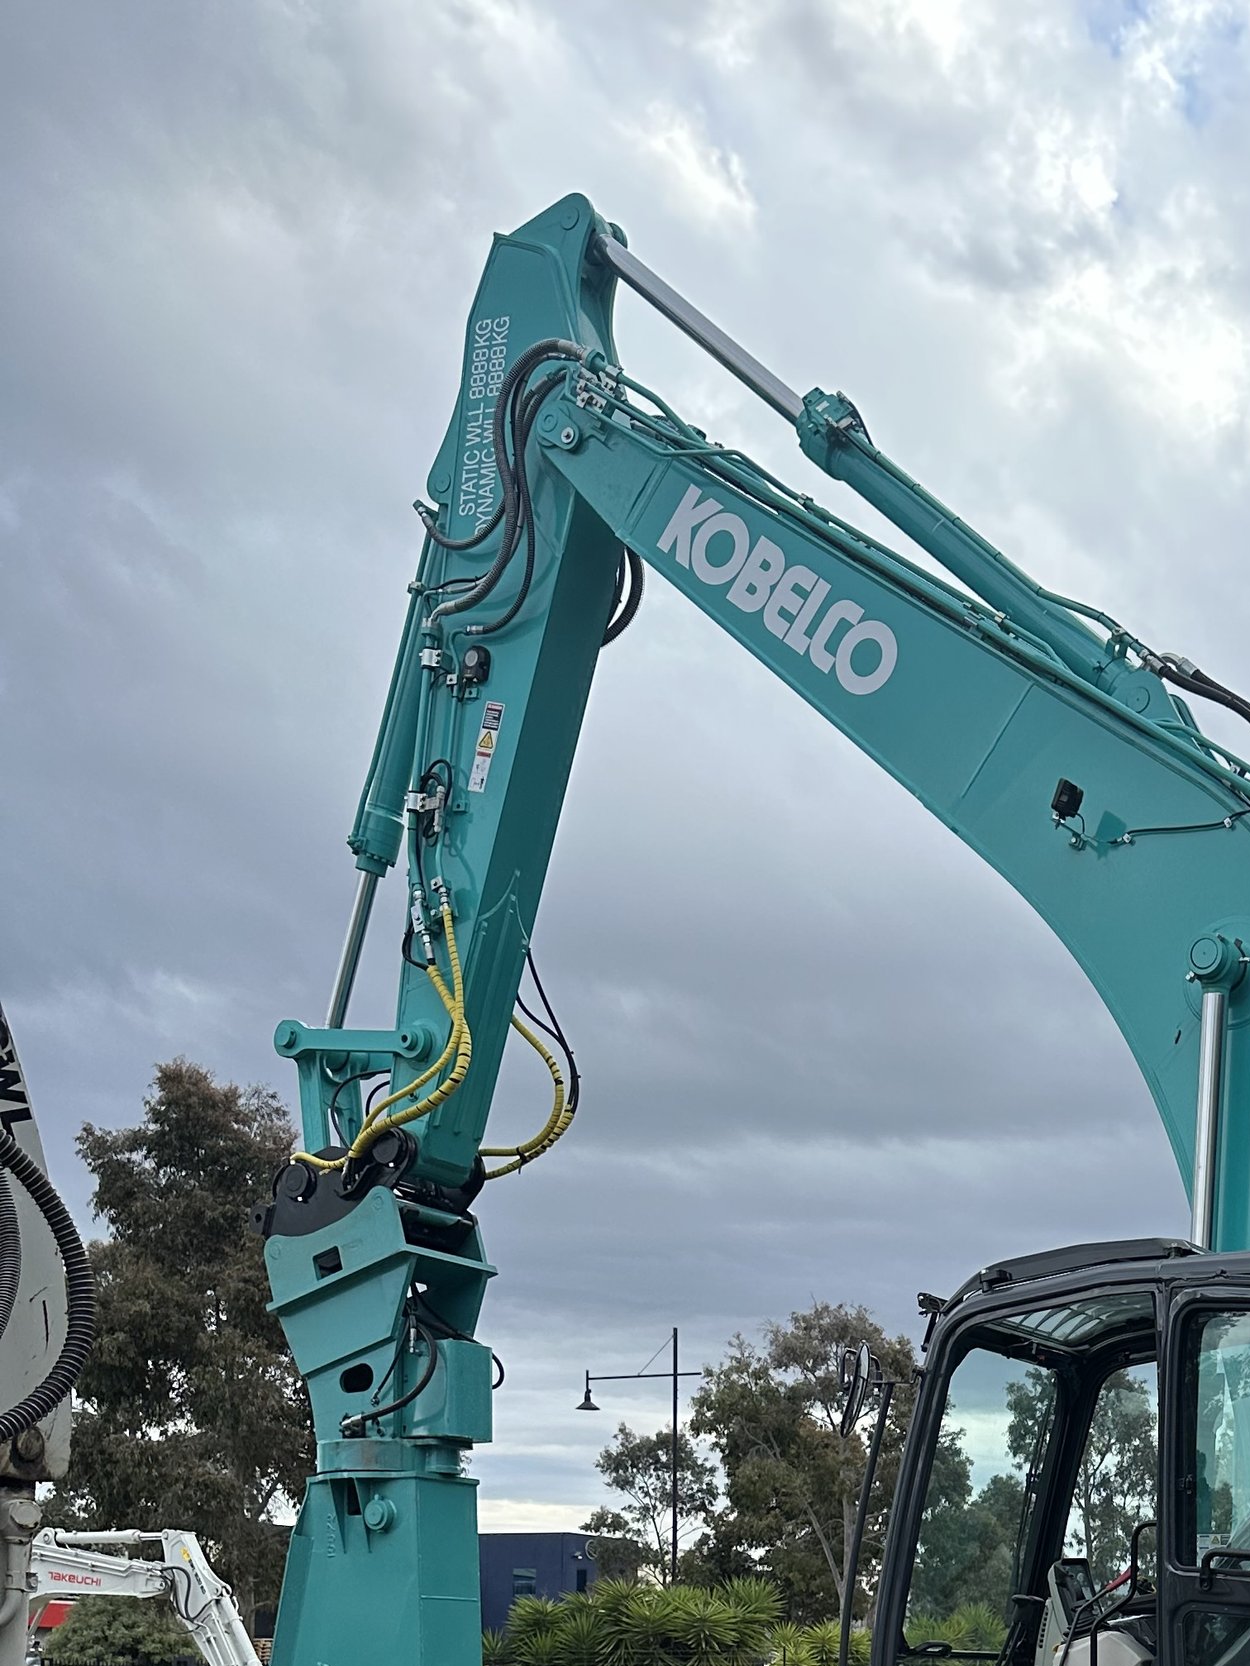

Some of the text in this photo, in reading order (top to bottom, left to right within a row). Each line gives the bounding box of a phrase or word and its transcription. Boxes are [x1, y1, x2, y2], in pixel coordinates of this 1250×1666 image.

[466, 402, 484, 448] WLL
[459, 449, 481, 517] STATIC
[656, 483, 898, 696] KOBELCO
